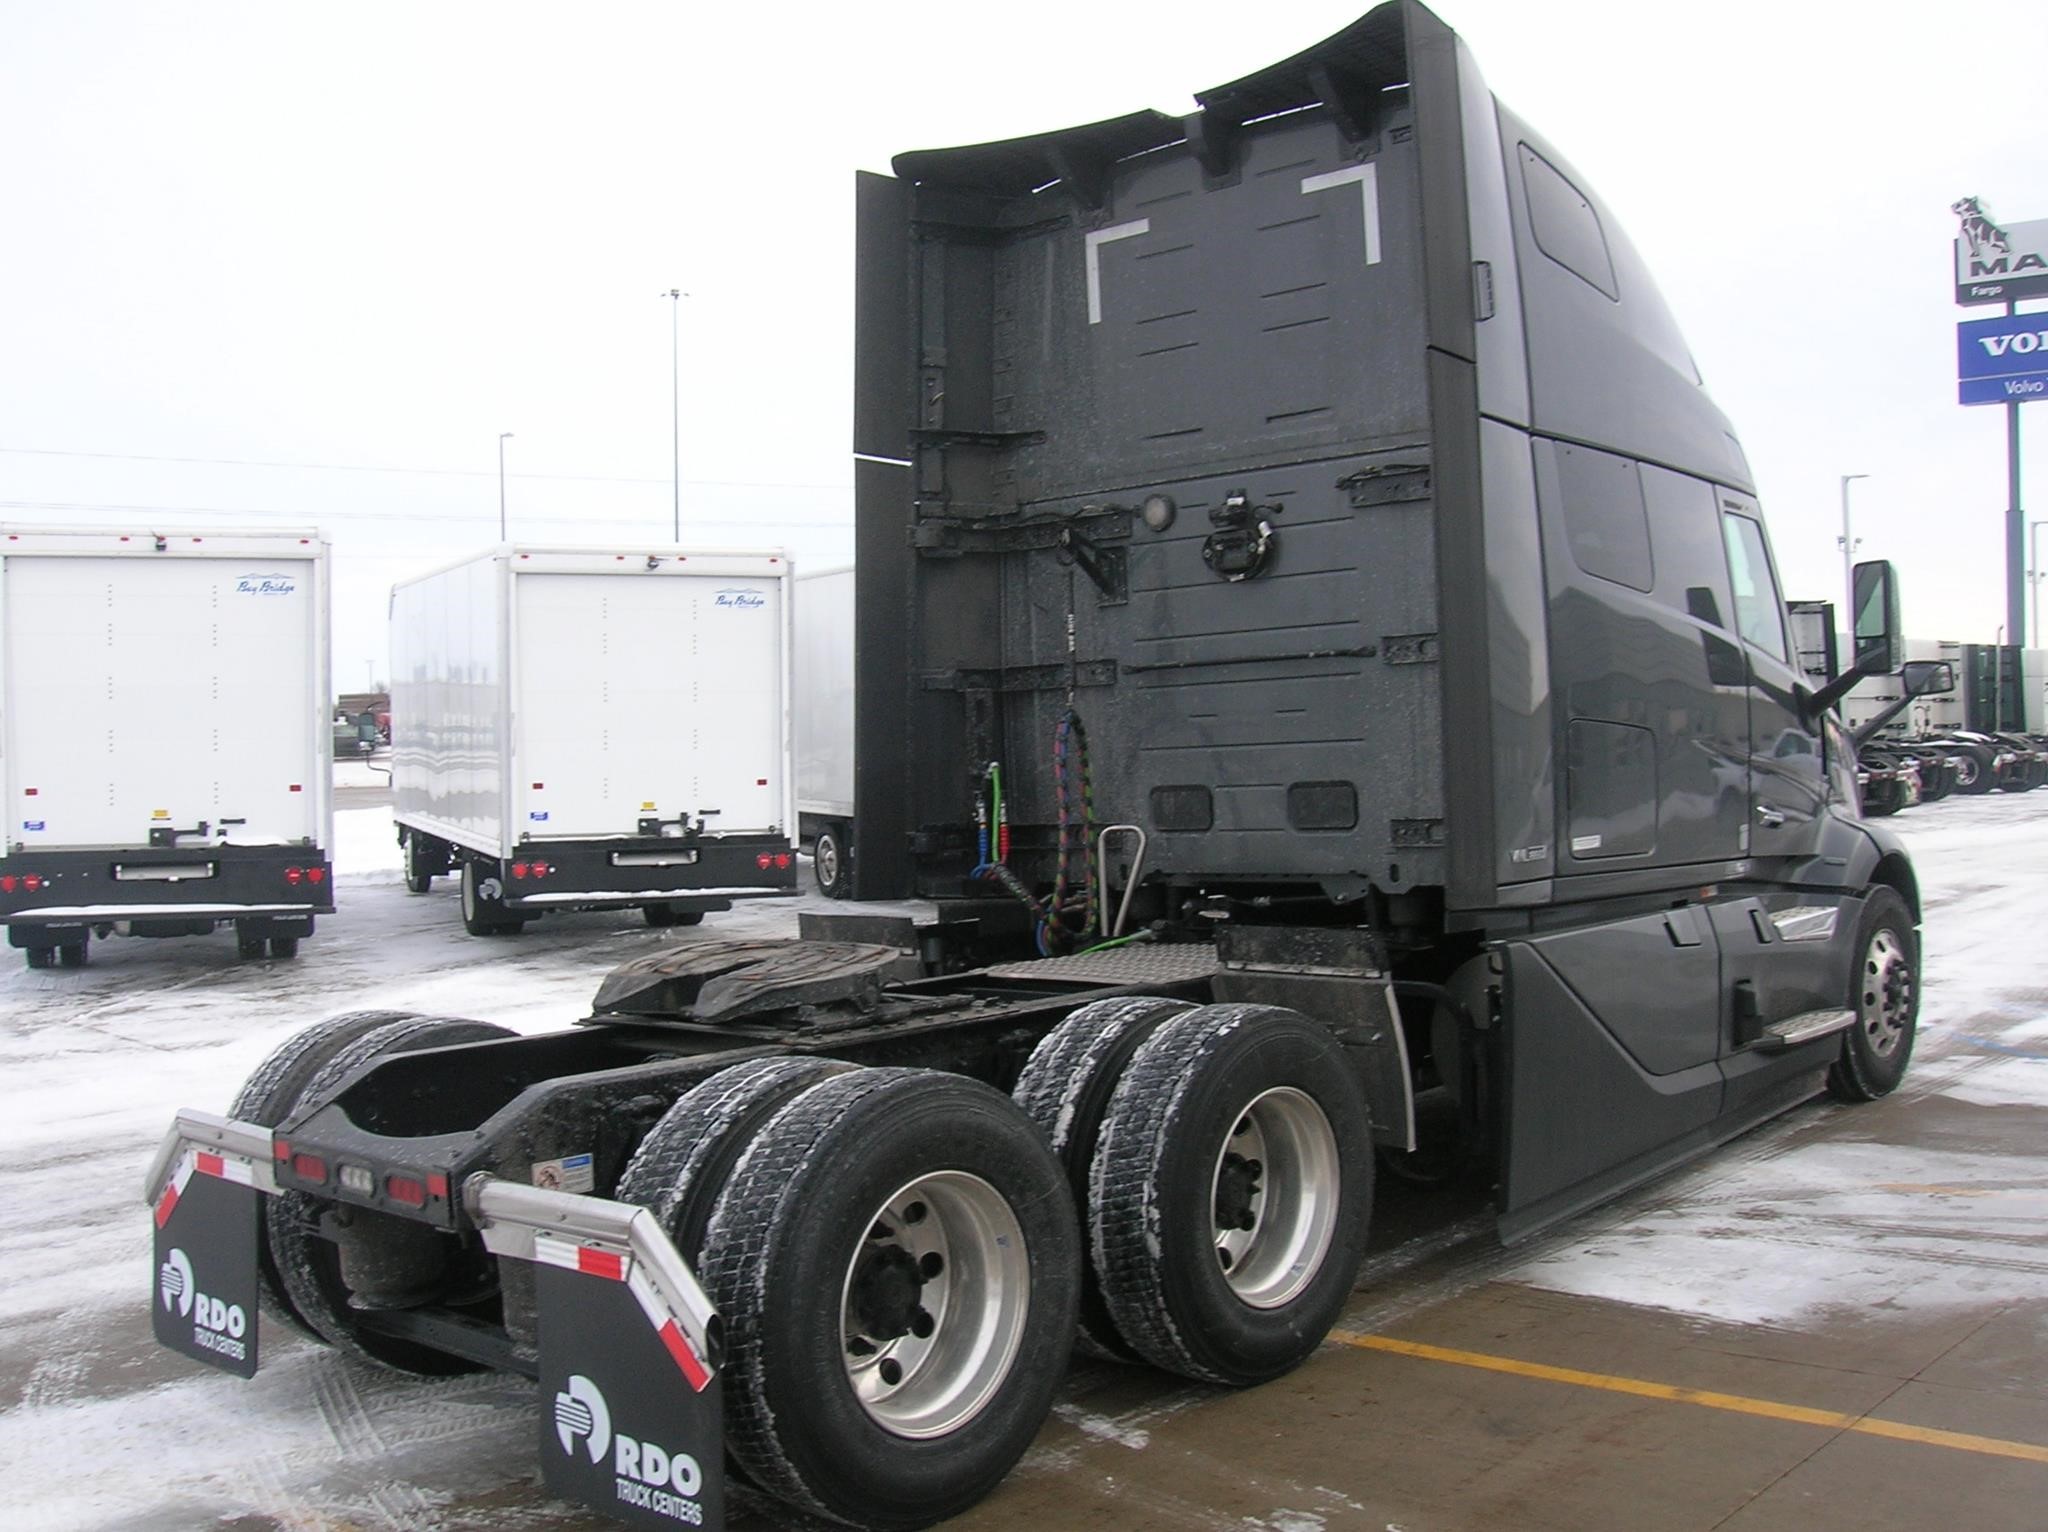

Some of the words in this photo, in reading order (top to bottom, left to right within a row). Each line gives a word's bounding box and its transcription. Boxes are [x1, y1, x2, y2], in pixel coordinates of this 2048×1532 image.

[1971, 285, 2003, 297] Fargo
[2004, 380, 2044, 395] Volvo
[236, 580, 257, 595] Bay
[259, 580, 294, 595] Bridge
[734, 594, 764, 608] Bridge
[195, 1292, 246, 1338] RDO
[615, 1433, 702, 1497] RDO
[615, 1477, 653, 1509] TRUCK
[652, 1489, 703, 1526] CENTERS
